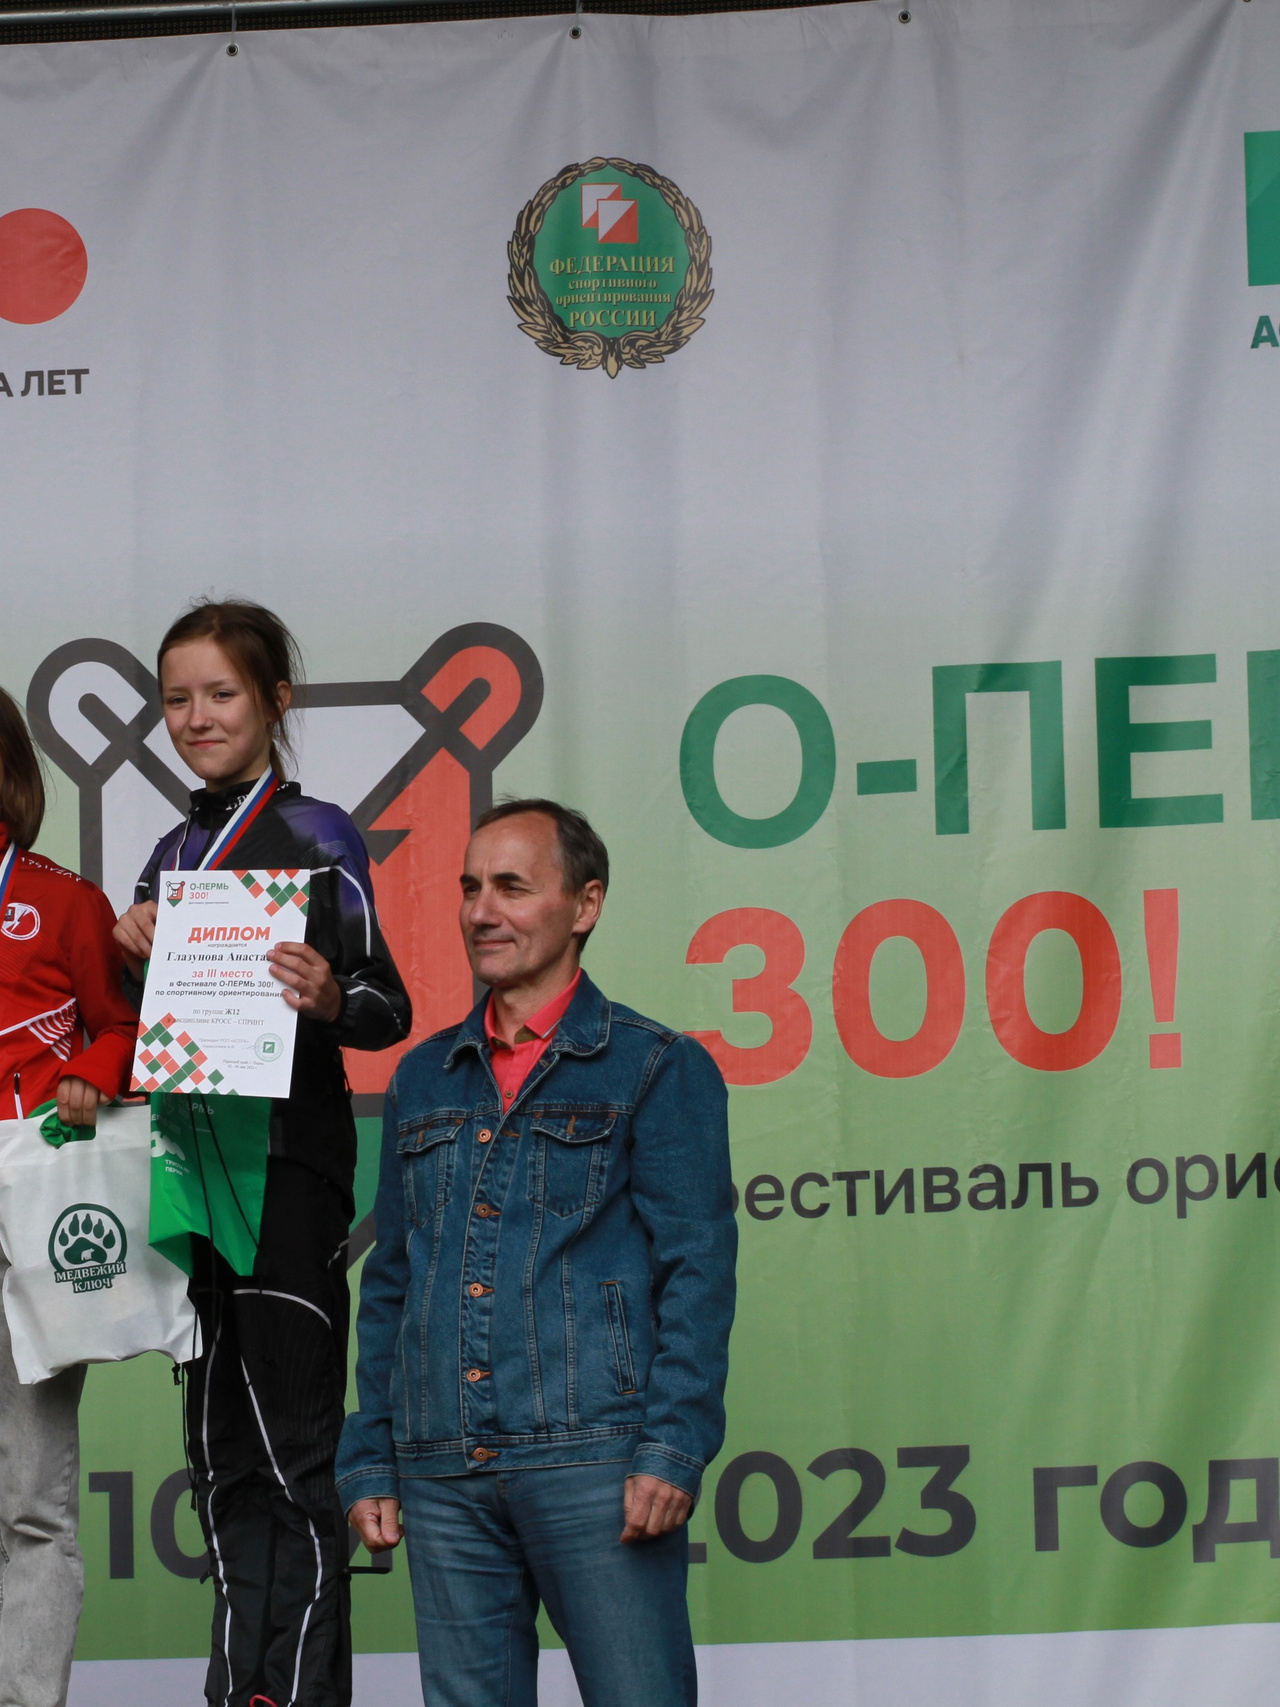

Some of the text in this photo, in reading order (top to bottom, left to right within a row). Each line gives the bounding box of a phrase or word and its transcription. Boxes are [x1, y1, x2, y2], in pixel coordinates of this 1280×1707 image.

[549, 255, 675, 276] ФЕДЕРАЦИЯ
[568, 278, 657, 292] спортивного
[555, 292, 672, 308] ориентирования
[570, 310, 656, 327] РОССИИ
[1250, 315, 1280, 349] А
[21, 368, 90, 397] ЛЕТ
[189, 892, 208, 900] 300!
[187, 926, 271, 943] ДИПЛОМ
[167, 952, 223, 964] Глазунова
[192, 970, 204, 978] за
[220, 970, 253, 978] место
[166, 990, 217, 998] спортивному
[218, 990, 283, 998] ориентировани
[681, 888, 1182, 1086] 300!
[728, 1151, 1280, 1221] естиваль ори
[56, 1261, 125, 1281] МЕДВЕЖИЙ
[74, 1278, 111, 1292] КЛЮЧ
[688, 1445, 976, 1563] 023
